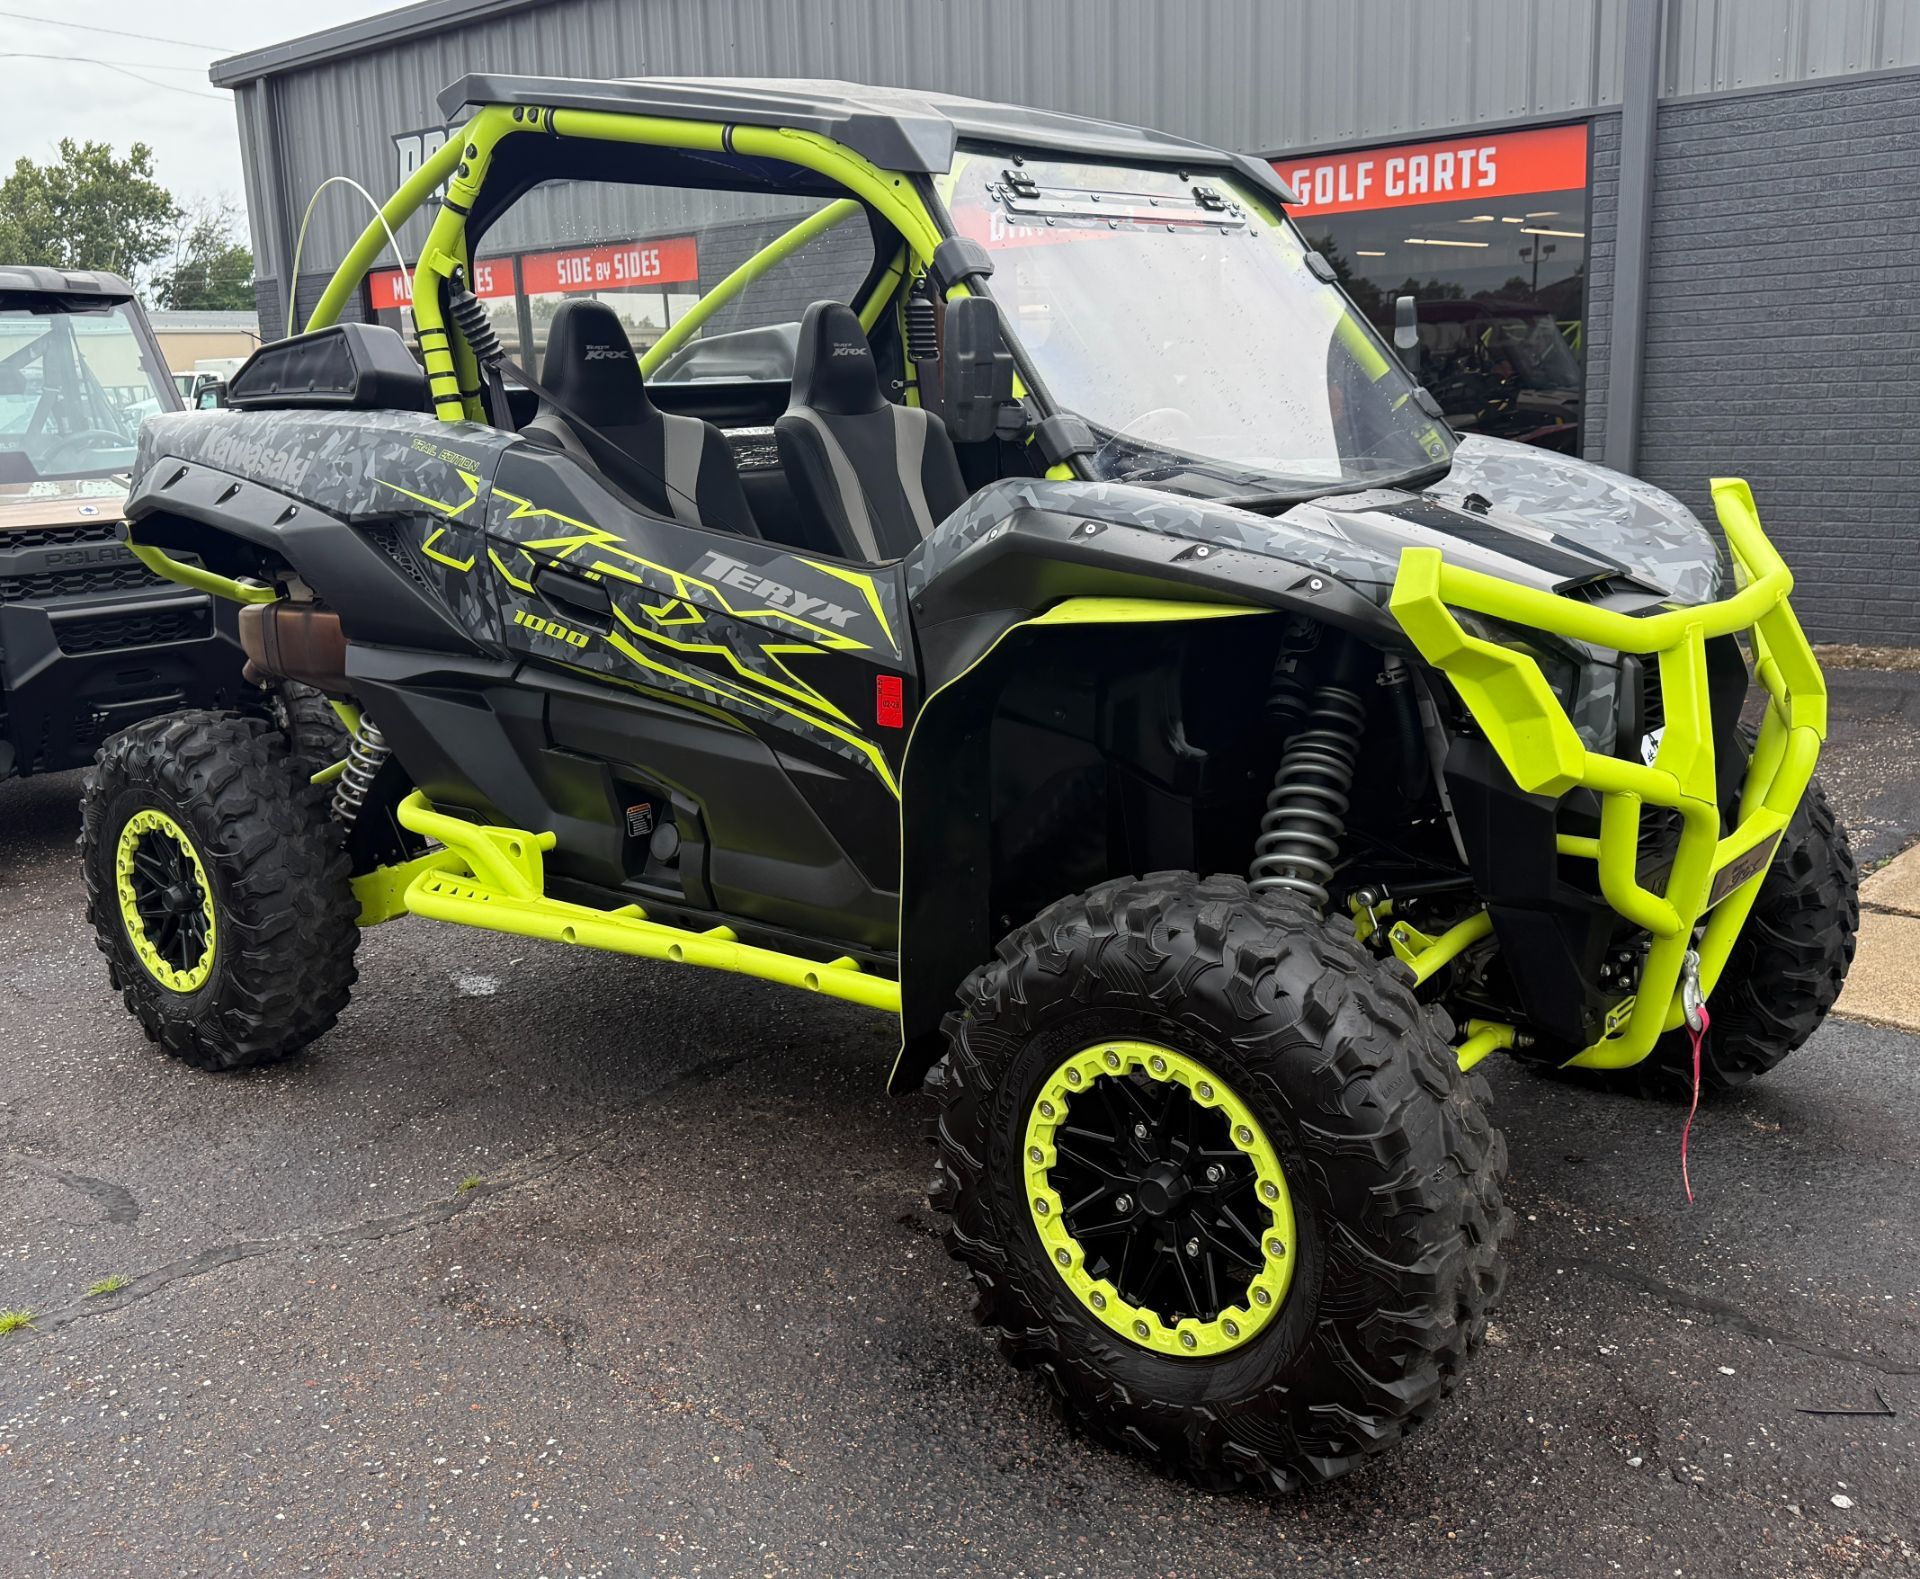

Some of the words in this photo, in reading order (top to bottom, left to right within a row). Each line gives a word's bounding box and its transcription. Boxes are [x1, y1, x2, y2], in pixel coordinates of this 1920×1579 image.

[1291, 161, 1374, 207] GOLF
[1385, 147, 1498, 197] CARTS
[557, 257, 592, 285] SIDE
[596, 261, 612, 281] BY
[613, 249, 660, 279] SIDES
[199, 425, 316, 487] Kawasaki
[411, 438, 438, 457] TRAIL
[438, 448, 481, 472] EDITION
[44, 547, 137, 567] POLAR
[700, 550, 862, 628] TERYX
[511, 609, 590, 648] 1000
